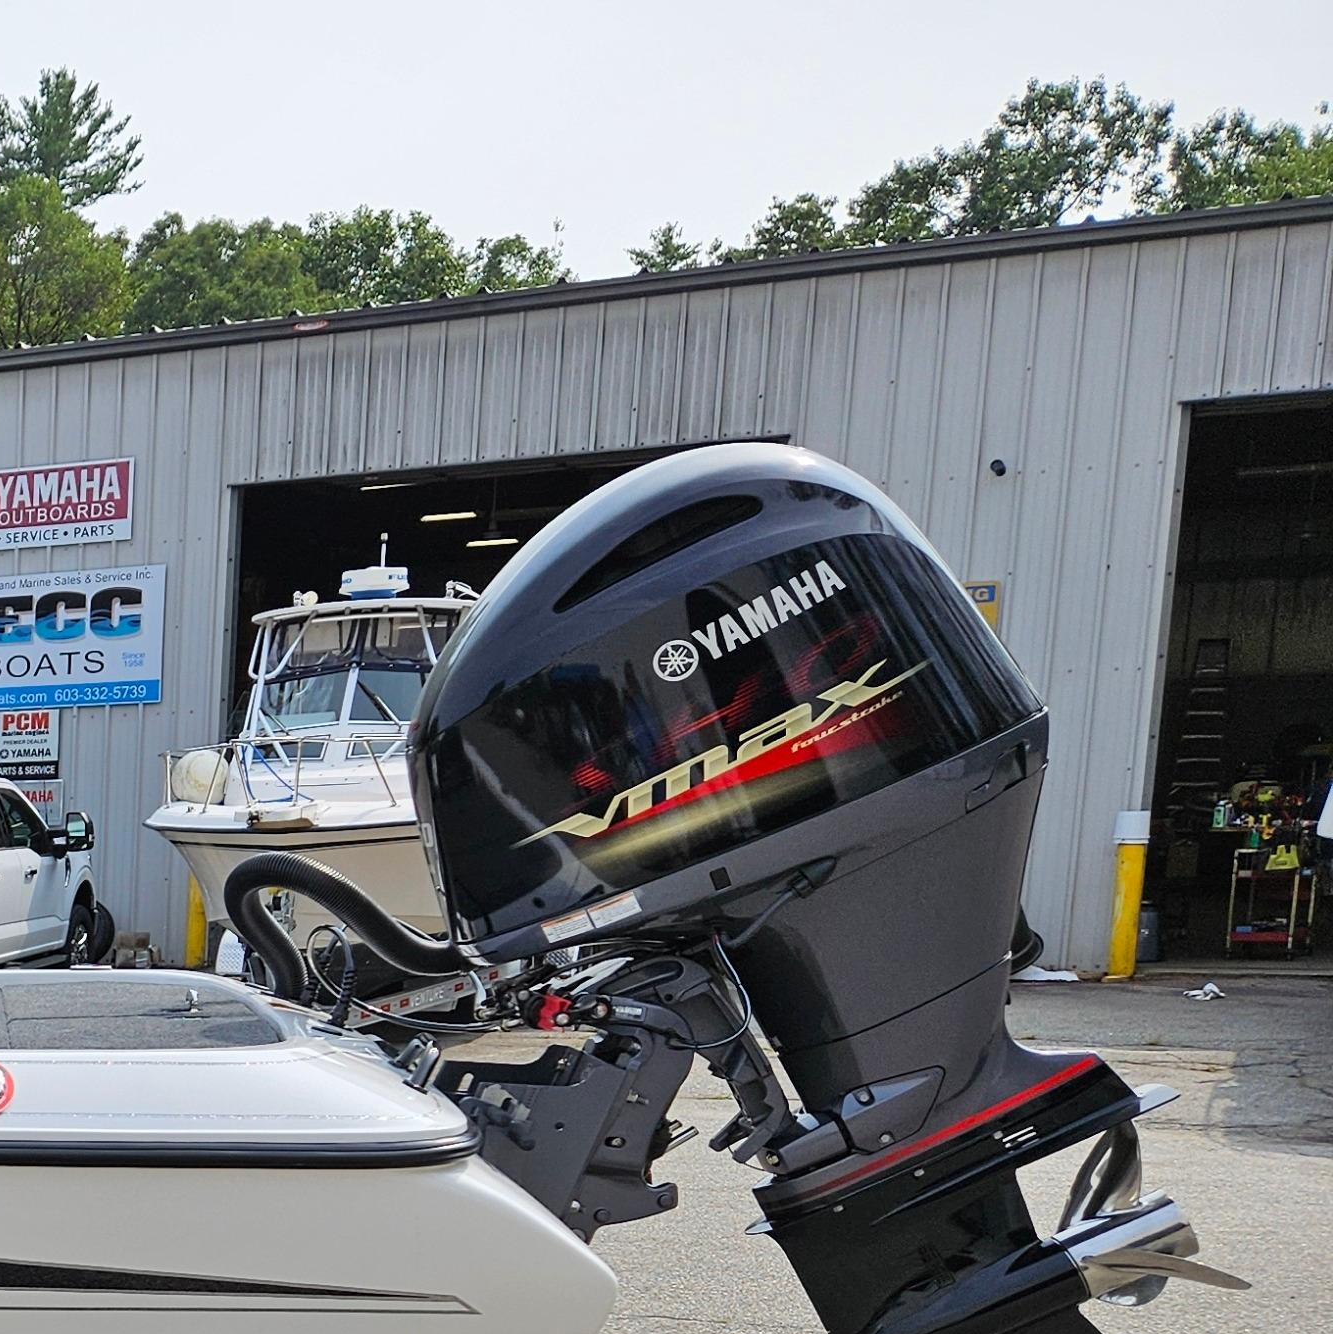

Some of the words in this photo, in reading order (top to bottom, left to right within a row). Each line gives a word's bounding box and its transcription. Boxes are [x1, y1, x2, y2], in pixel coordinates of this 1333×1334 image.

[6, 529, 59, 544] SERVICE
[73, 524, 114, 538] PARTS
[19, 579, 51, 588] Marine
[54, 575, 81, 585] Sales
[85, 575, 91, 583] &
[95, 573, 132, 583] Service
[136, 570, 153, 579] Inc.
[691, 559, 847, 660] YAMAHA
[55, 685, 147, 702] 603-332-5739
[2, 712, 49, 730] PCM
[10, 747, 51, 758] YAMAHA
[18, 766, 24, 775] &
[25, 765, 55, 775] SERVICE
